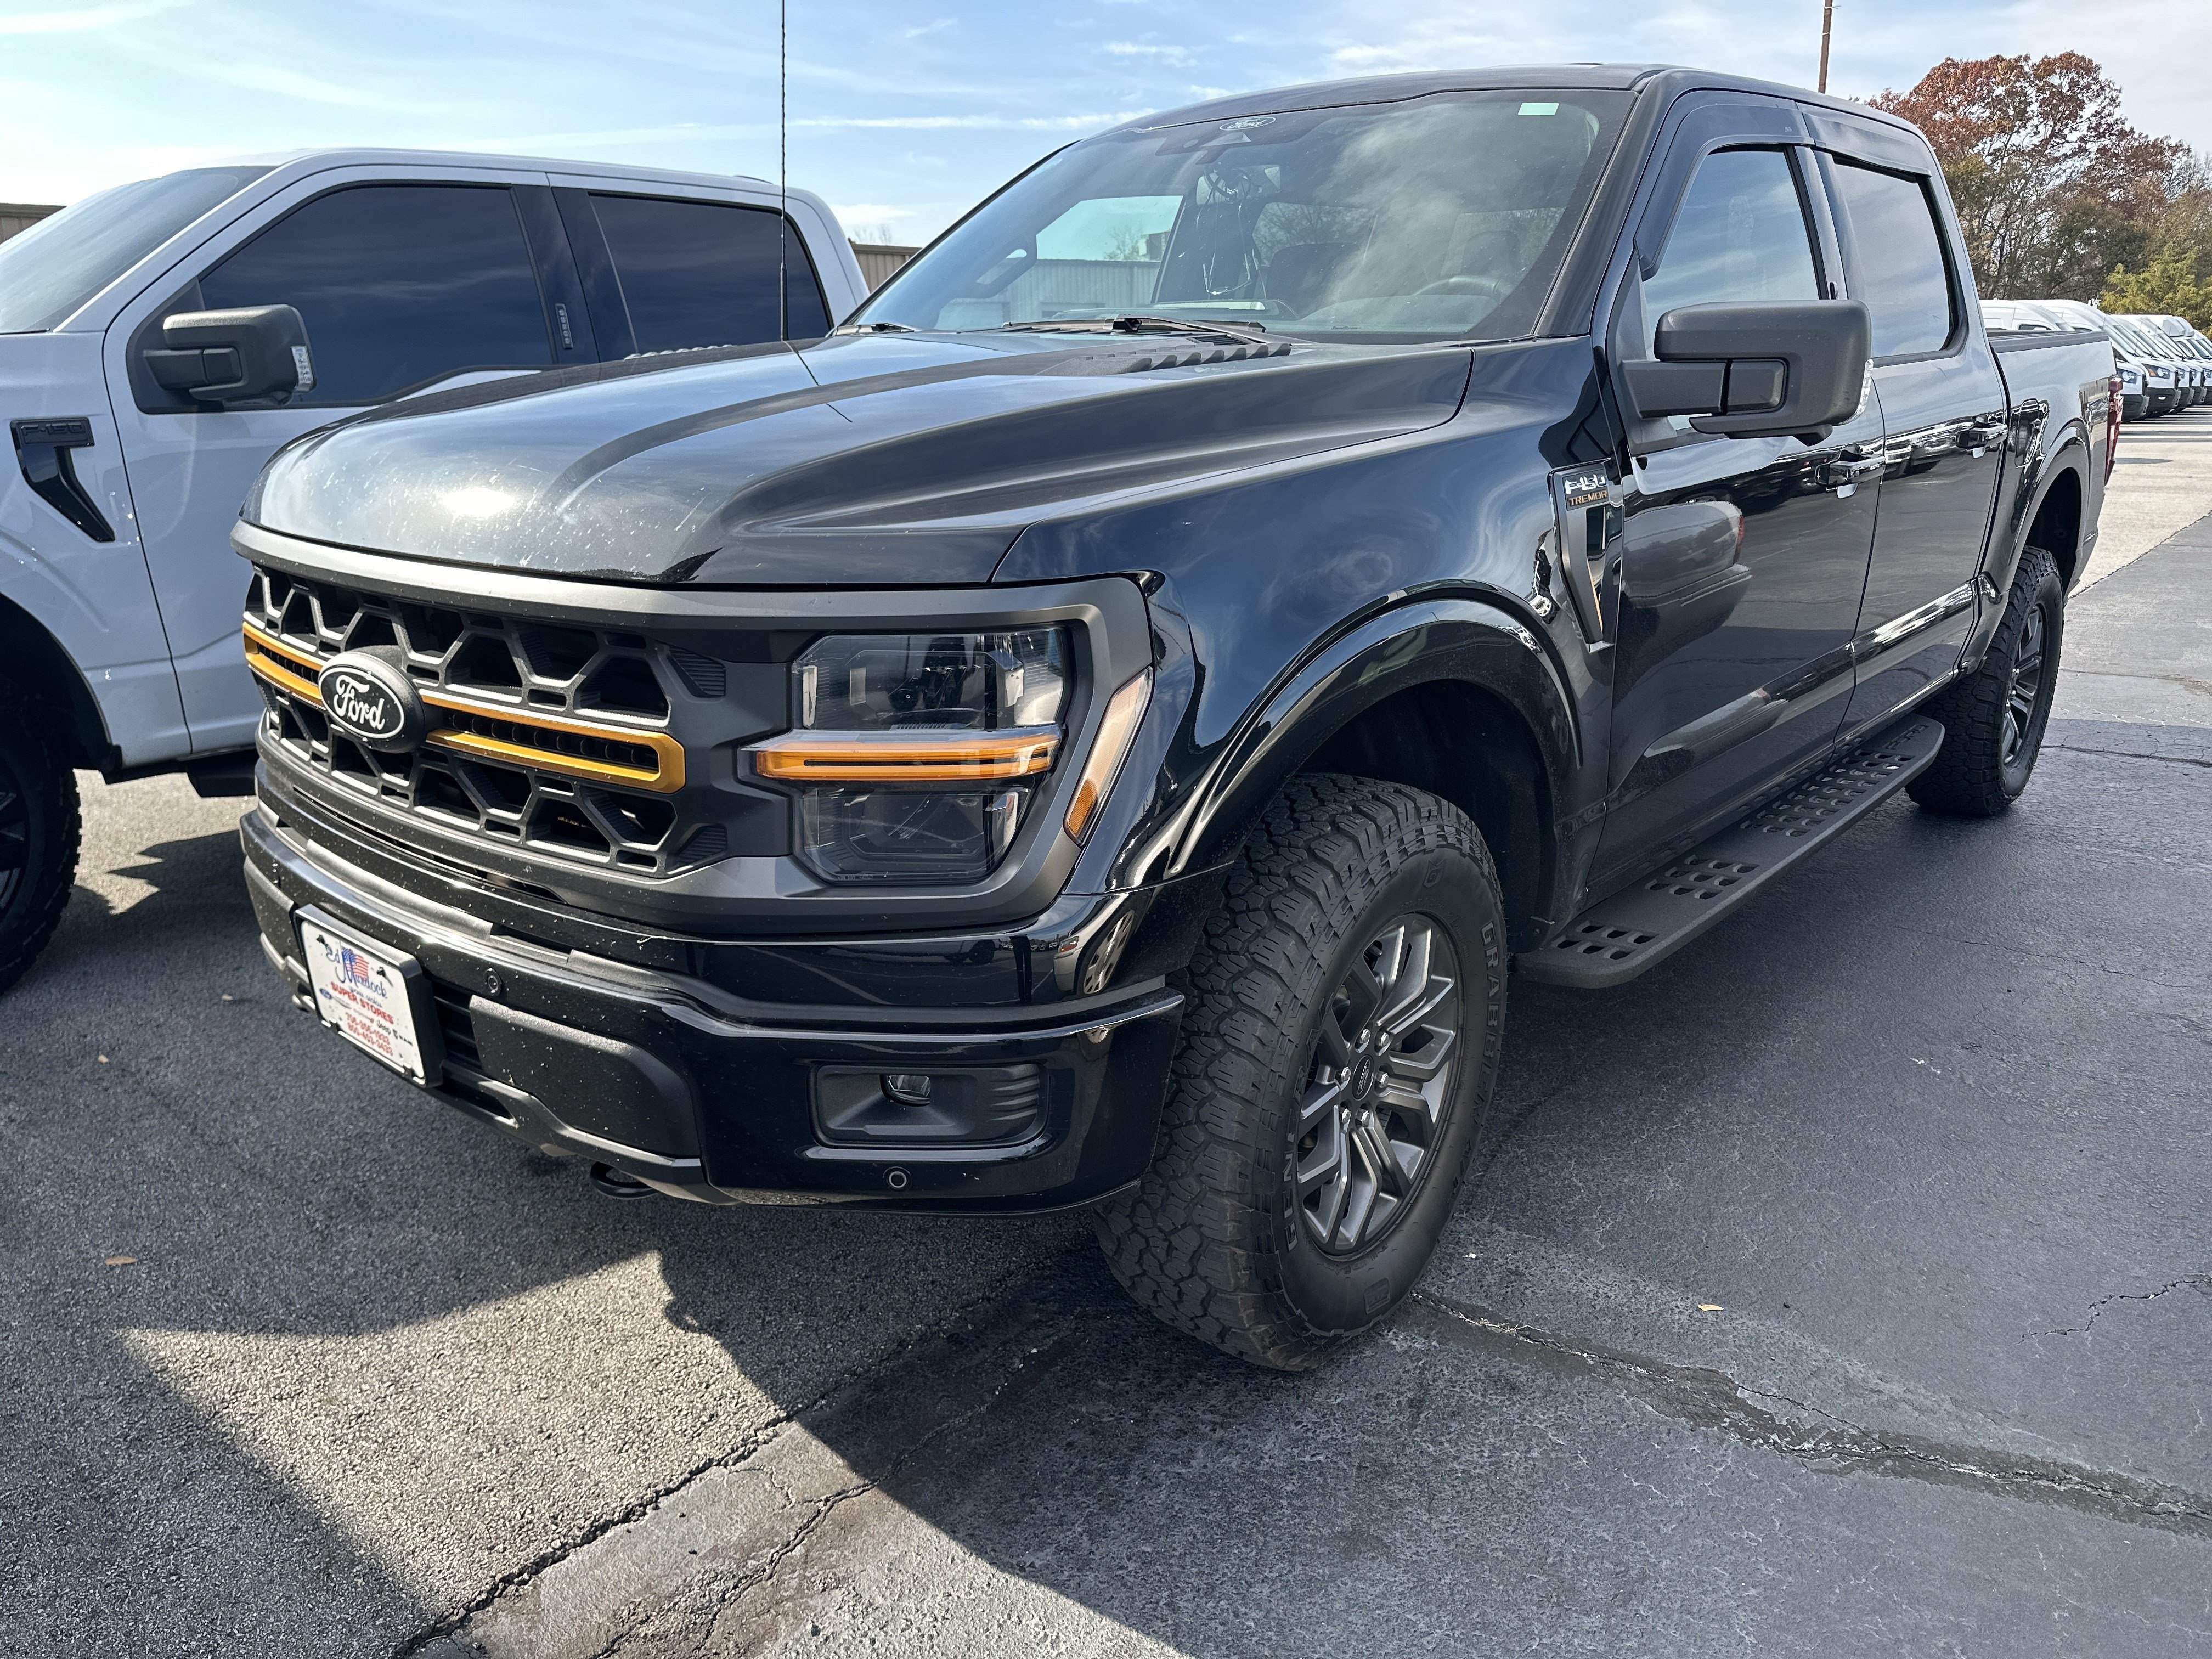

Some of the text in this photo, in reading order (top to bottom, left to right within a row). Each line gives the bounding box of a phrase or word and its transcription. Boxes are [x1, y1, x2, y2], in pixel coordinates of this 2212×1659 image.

[1227, 118, 1267, 129] Ford
[21, 423, 82, 437] F-150
[1565, 473, 1606, 494] F-150
[1569, 490, 1607, 506] TREMOR
[333, 674, 386, 730] Ford
[330, 981, 358, 1003] SUPER
[359, 998, 394, 1025] STORES
[1470, 921, 1502, 1125] GRABBER
